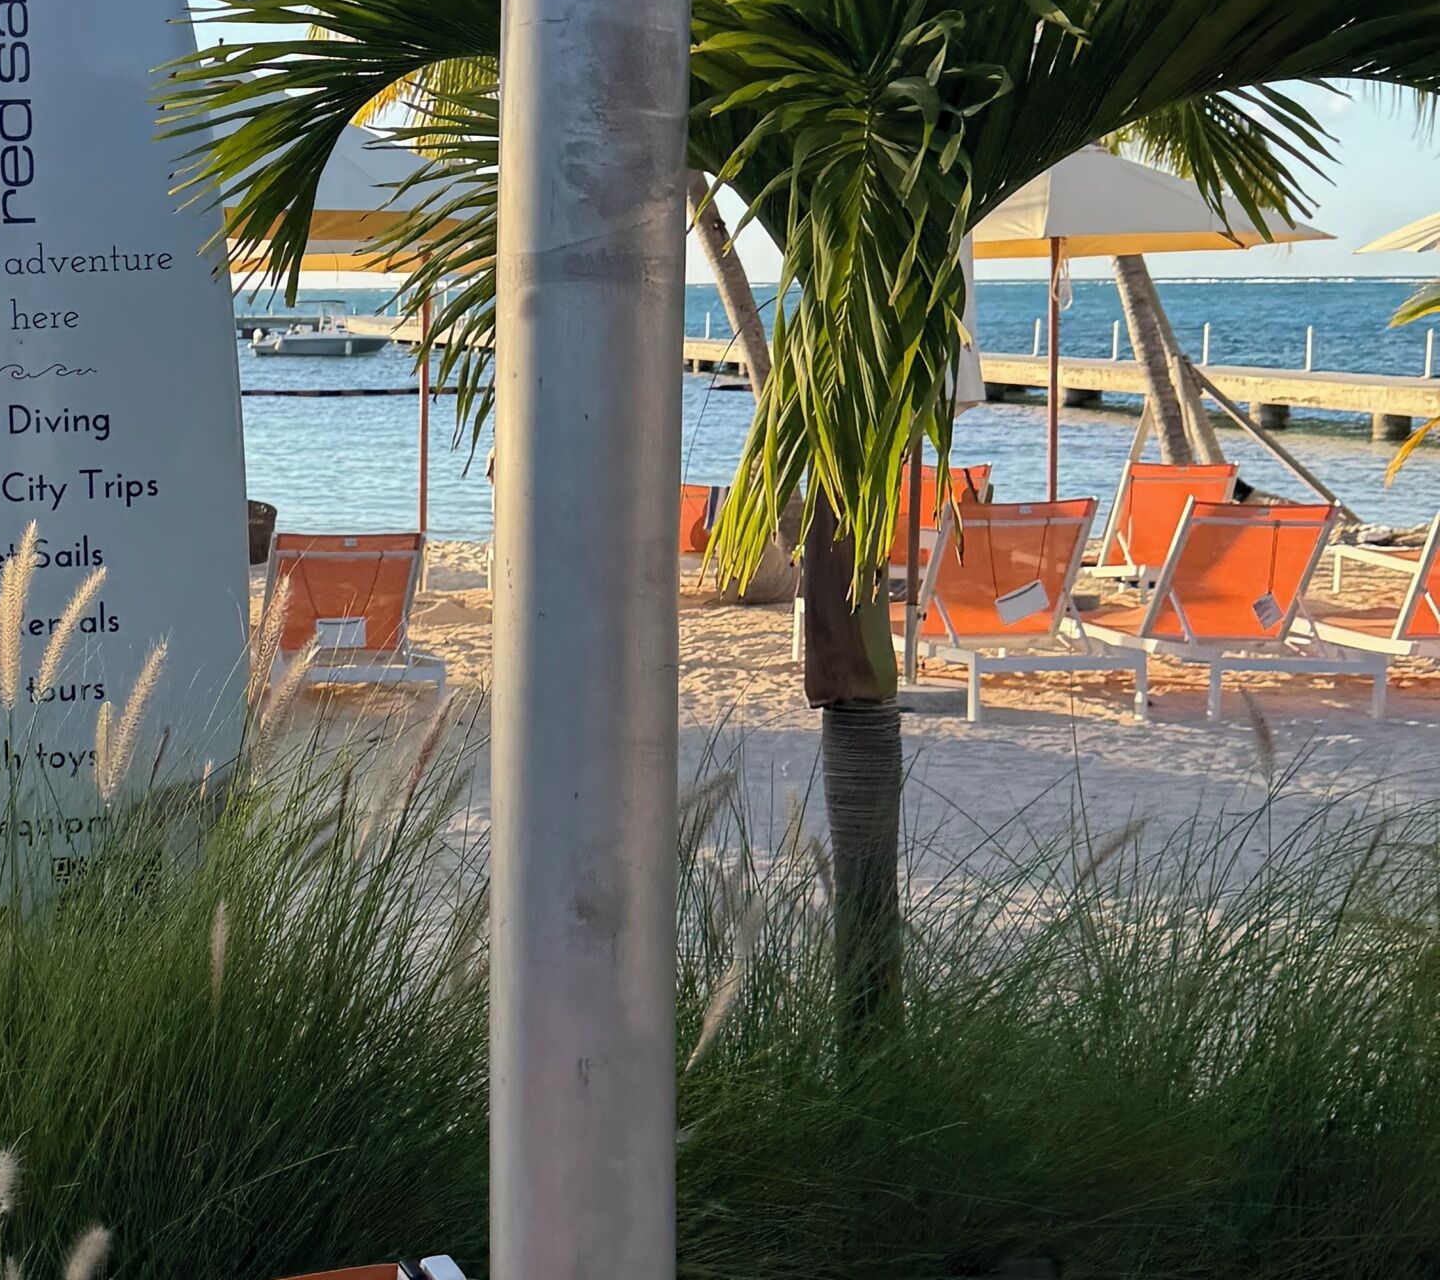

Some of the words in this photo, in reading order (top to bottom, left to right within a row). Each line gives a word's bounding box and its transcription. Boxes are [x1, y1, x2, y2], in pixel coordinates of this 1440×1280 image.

[4, 243, 174, 276] adventure
[10, 299, 80, 330] here
[8, 405, 111, 441] Diving
[2, 472, 68, 511] City
[79, 470, 159, 508] Trips
[32, 534, 104, 569] Sails
[19, 601, 120, 637] enals
